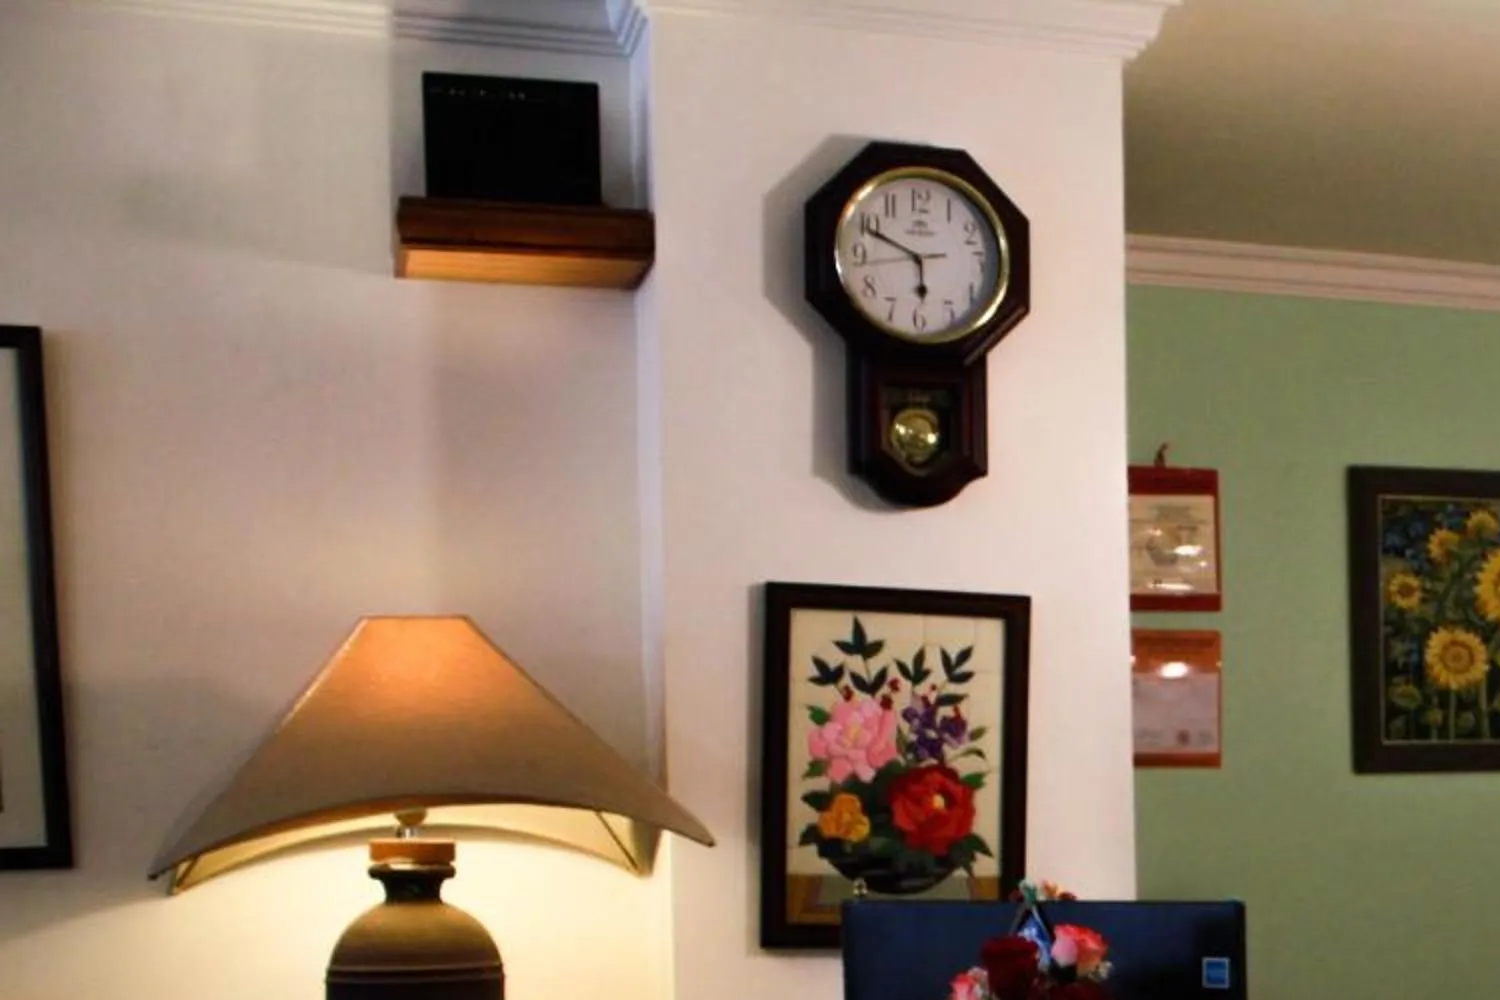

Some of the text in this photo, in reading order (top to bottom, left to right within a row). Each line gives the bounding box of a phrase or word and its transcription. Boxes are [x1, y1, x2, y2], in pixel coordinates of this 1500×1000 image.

[885, 194, 896, 217] 11
[911, 188, 930, 213] 12
[860, 213, 880, 235] 10
[963, 222, 978, 246] 2
[852, 244, 867, 266] 9
[863, 276, 877, 298] 8
[884, 297, 896, 321] 7
[912, 305, 927, 330] 6
